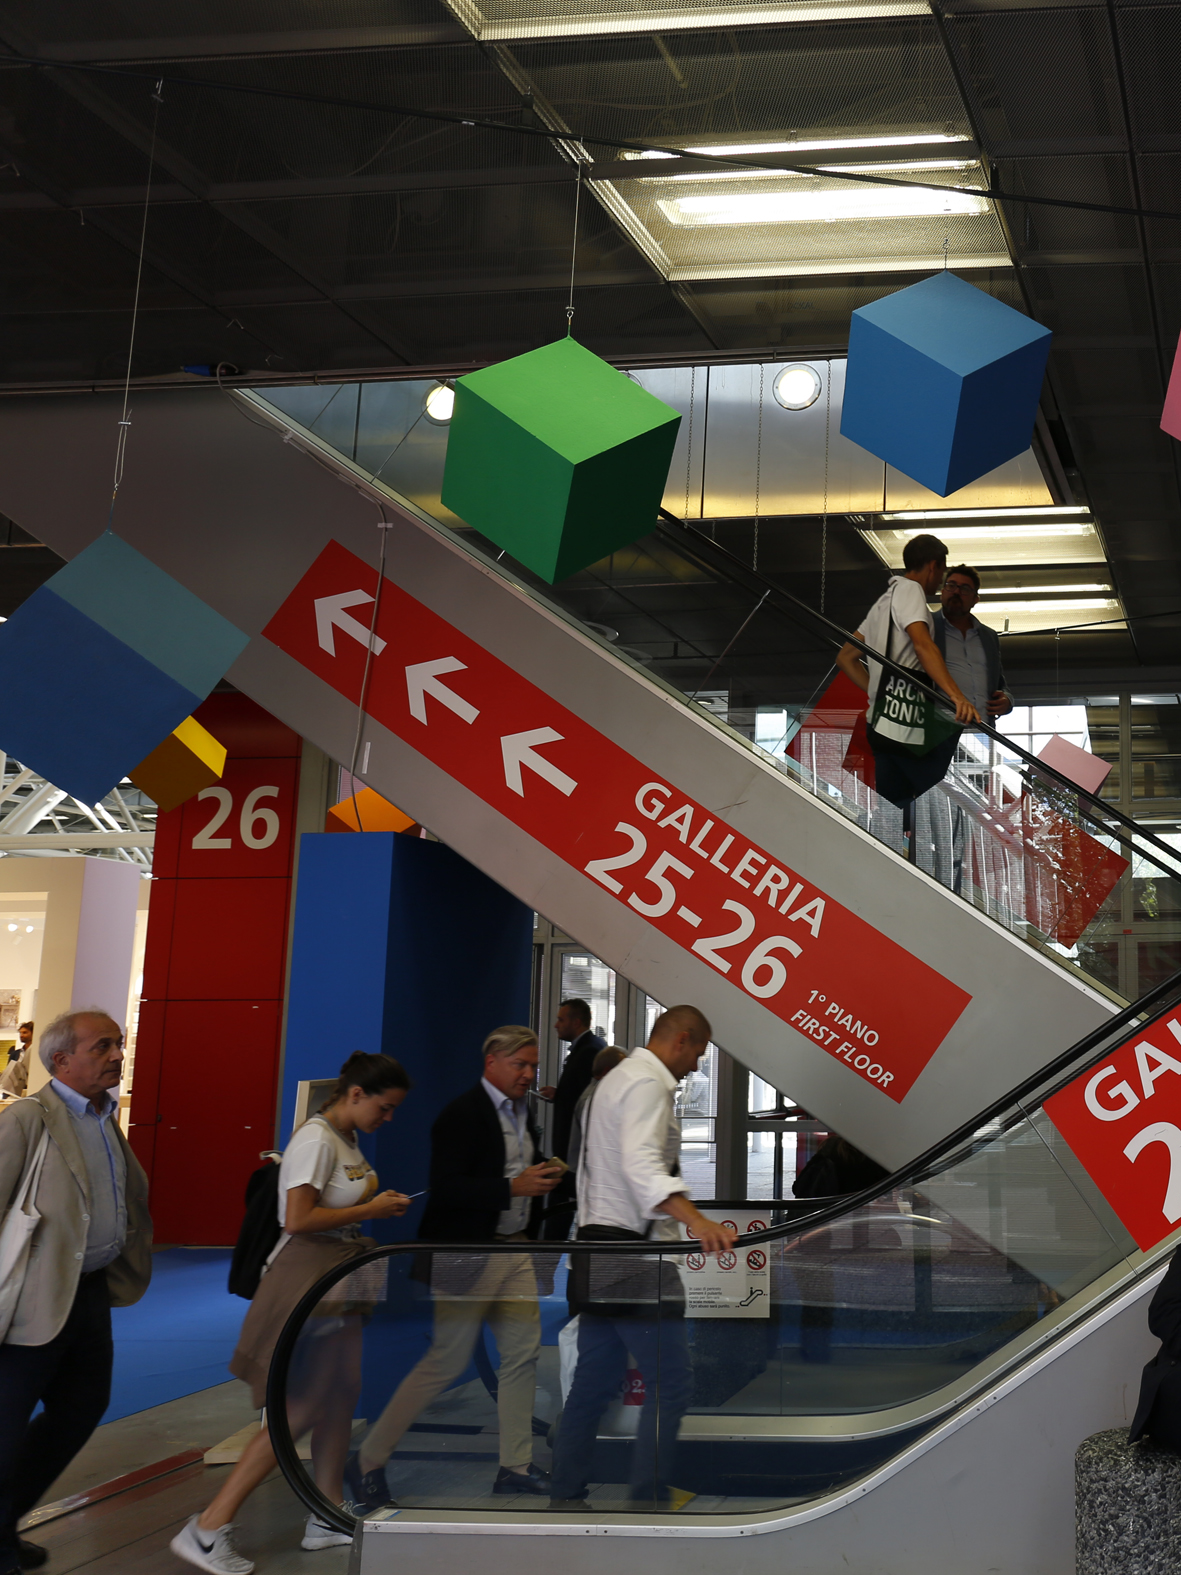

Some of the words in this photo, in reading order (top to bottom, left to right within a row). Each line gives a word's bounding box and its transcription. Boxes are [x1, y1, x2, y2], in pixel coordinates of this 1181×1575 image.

[883, 694, 925, 724] TONIC
[192, 786, 280, 849] 26
[635, 782, 826, 939] GALLERIA
[583, 821, 803, 999] 25-26
[790, 1009, 840, 1054] FIRST
[835, 1041, 895, 1088] FLOOR
[807, 989, 827, 1006] 1°
[825, 1002, 879, 1047] PIANO
